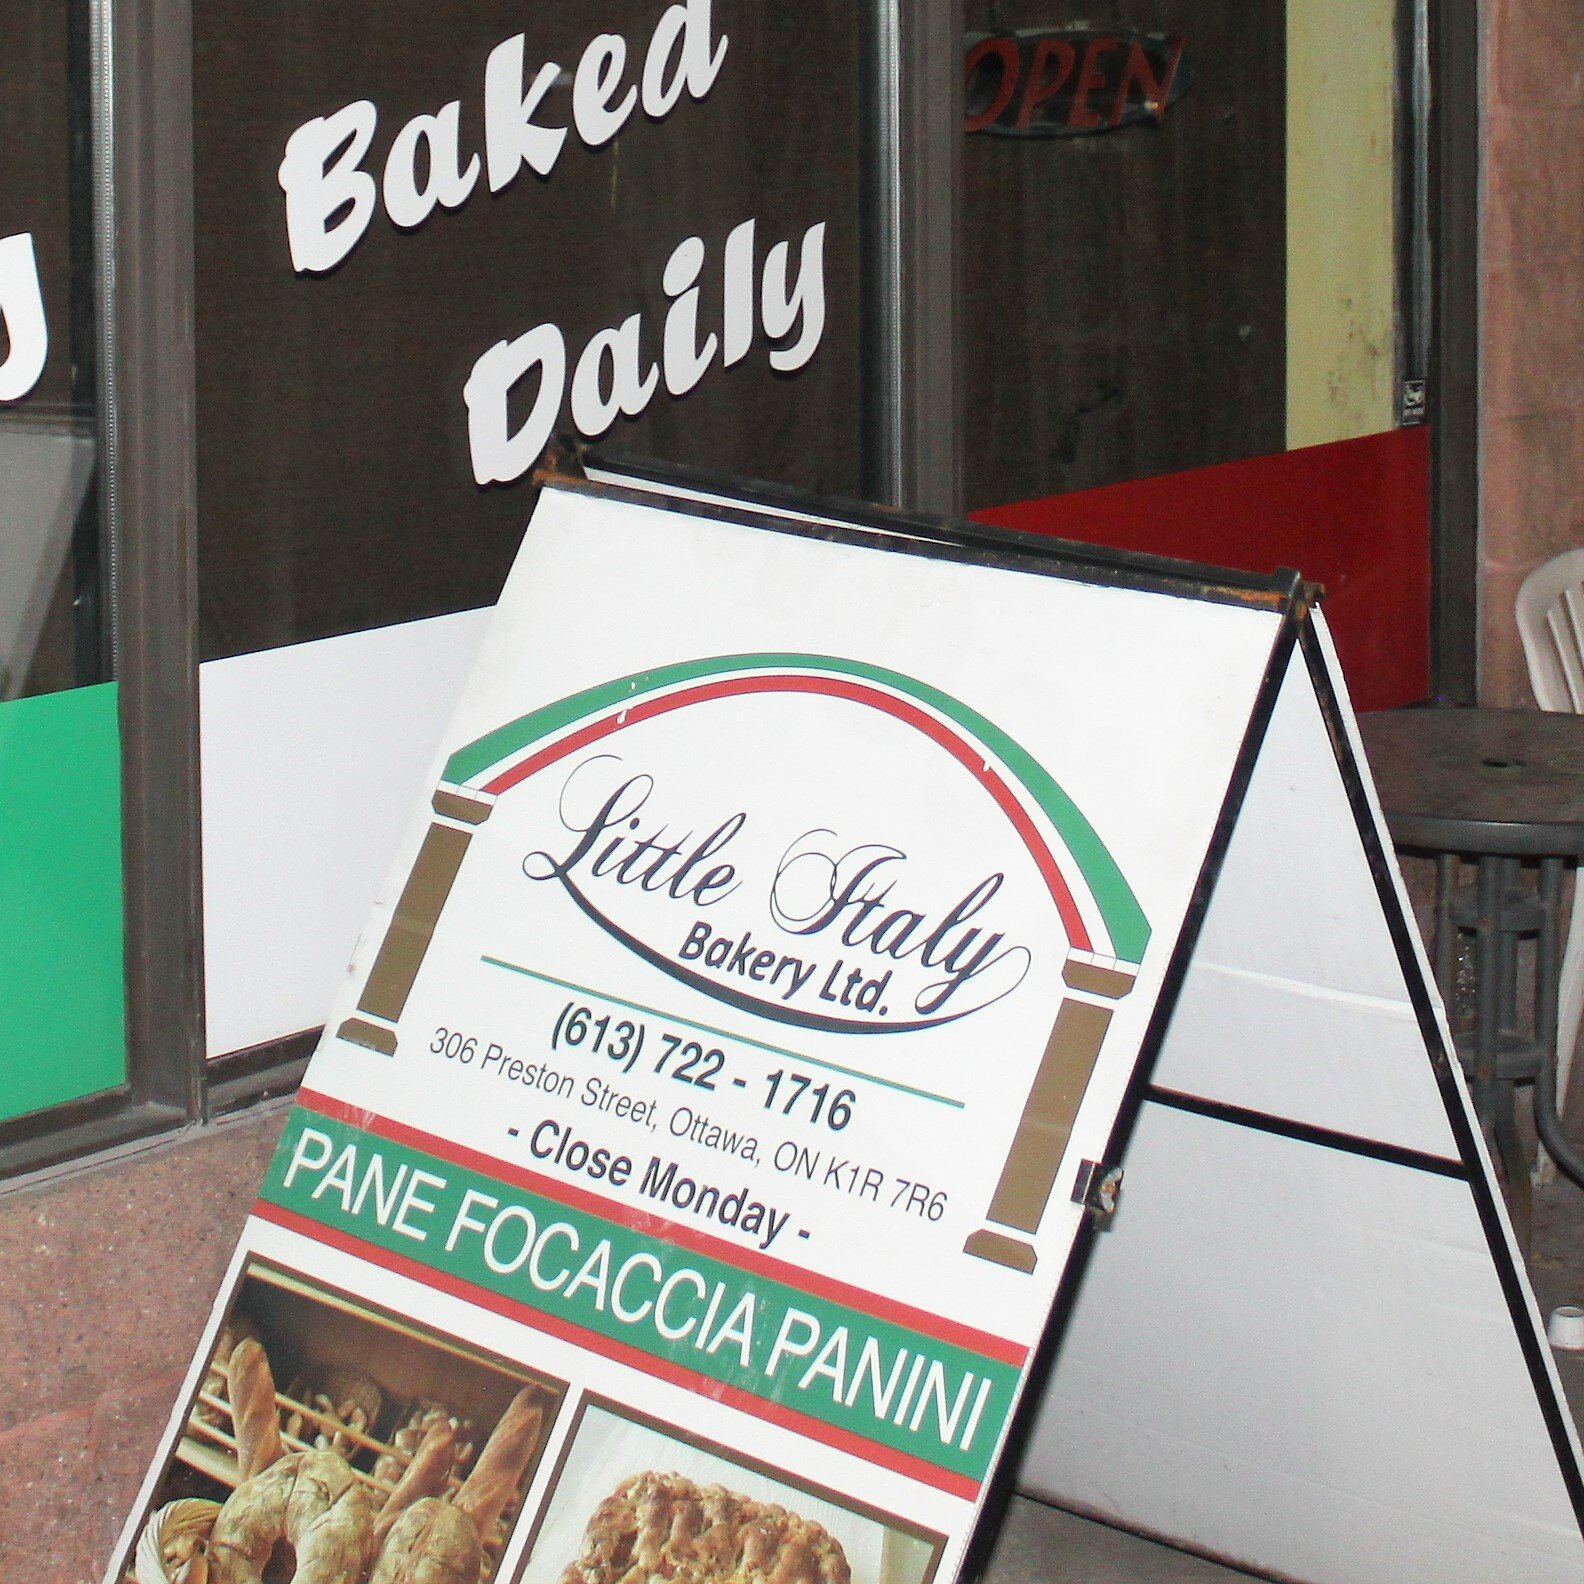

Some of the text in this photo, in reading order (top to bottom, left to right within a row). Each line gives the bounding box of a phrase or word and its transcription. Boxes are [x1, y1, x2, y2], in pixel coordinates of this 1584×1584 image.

[960, 36, 1188, 132] OPEN
[463, 218, 826, 486] Daily
[522, 755, 1028, 1016] Little Italy
[678, 921, 890, 1017] Bakery Ltd.
[429, 1028, 948, 1223] 306 Preston Street, Ottawa, ON K1R 7R6
[551, 1001, 646, 1073] (613)
[656, 1033, 726, 1090] 722
[763, 1068, 857, 1133] 1716
[529, 1120, 633, 1190] Close
[639, 1151, 791, 1253] Monday
[283, 1129, 993, 1453] PANE FOCACCIA PANINI
